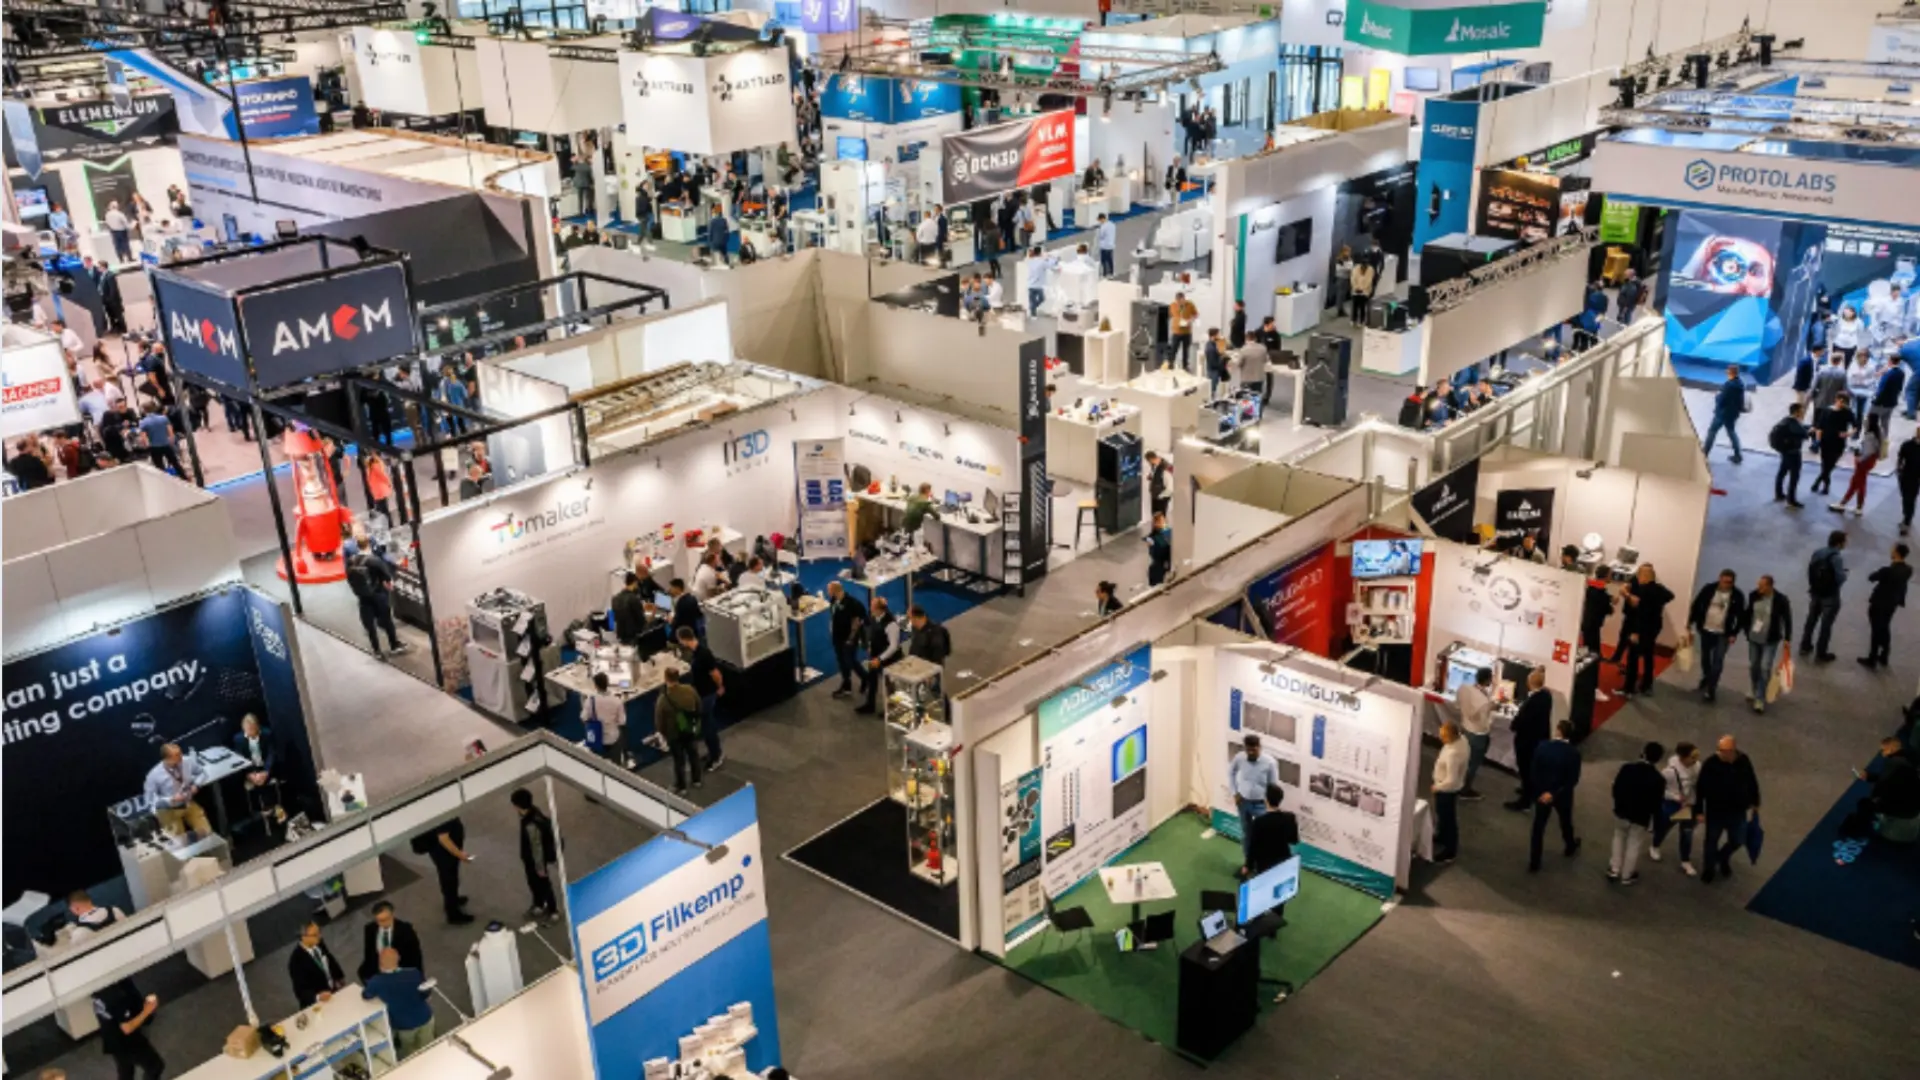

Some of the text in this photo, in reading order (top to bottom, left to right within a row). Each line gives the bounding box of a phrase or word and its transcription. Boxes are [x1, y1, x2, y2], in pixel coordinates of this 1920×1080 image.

[1460, 21, 1511, 41] Mosaic
[1719, 164, 1837, 193] PROTOLABS
[272, 297, 394, 357] AMCM
[723, 428, 770, 466] IT3D
[50, 657, 101, 700] just
[107, 654, 128, 673] a
[68, 659, 207, 720] company.
[592, 873, 745, 982] 3D Filkemp
